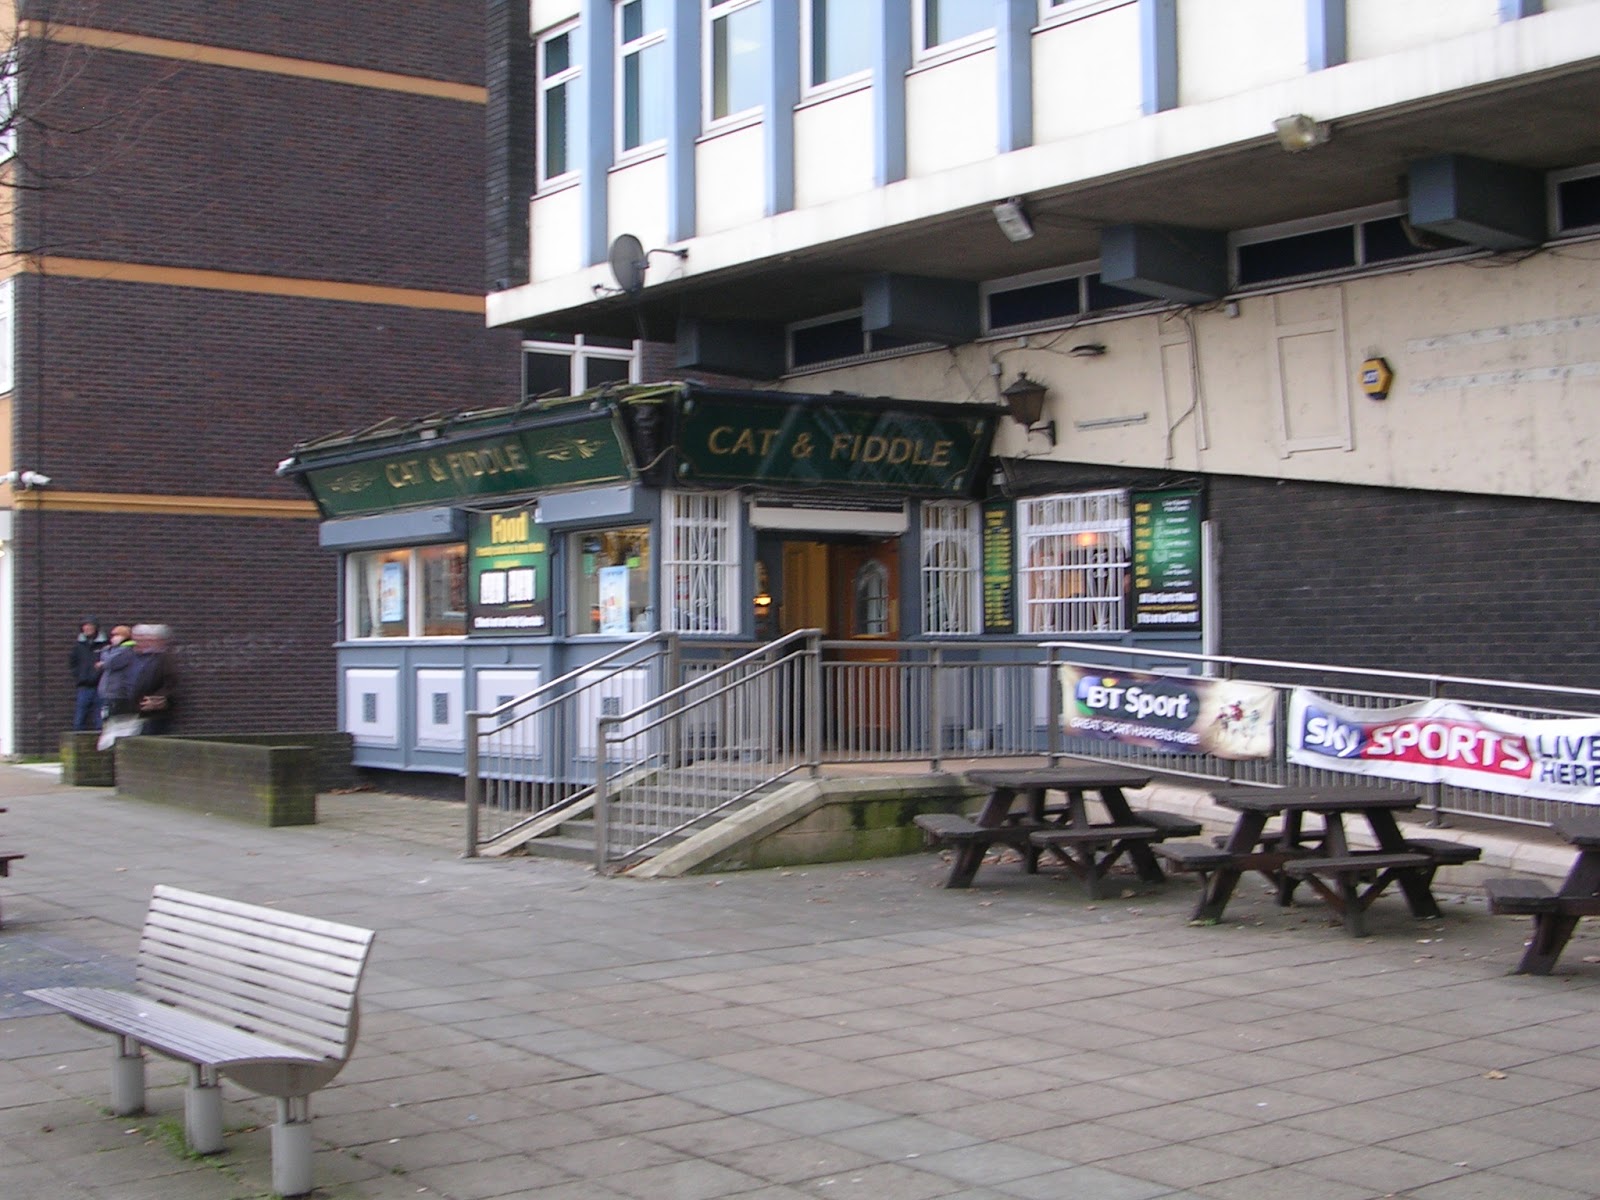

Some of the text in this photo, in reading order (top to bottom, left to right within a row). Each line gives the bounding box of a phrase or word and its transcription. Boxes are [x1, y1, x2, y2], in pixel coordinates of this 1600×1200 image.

[707, 426, 953, 467] CAT & FIDDLE
[385, 444, 528, 488] CAT & FIDDLE
[491, 511, 529, 544] Food
[1087, 685, 1191, 719] BT Sport
[1070, 716, 1102, 731] GREAT
[1102, 720, 1133, 736] SPORT
[1304, 715, 1531, 771] sky SPORTS
[1536, 735, 1600, 761] LIVE
[1540, 761, 1600, 787] HERE
